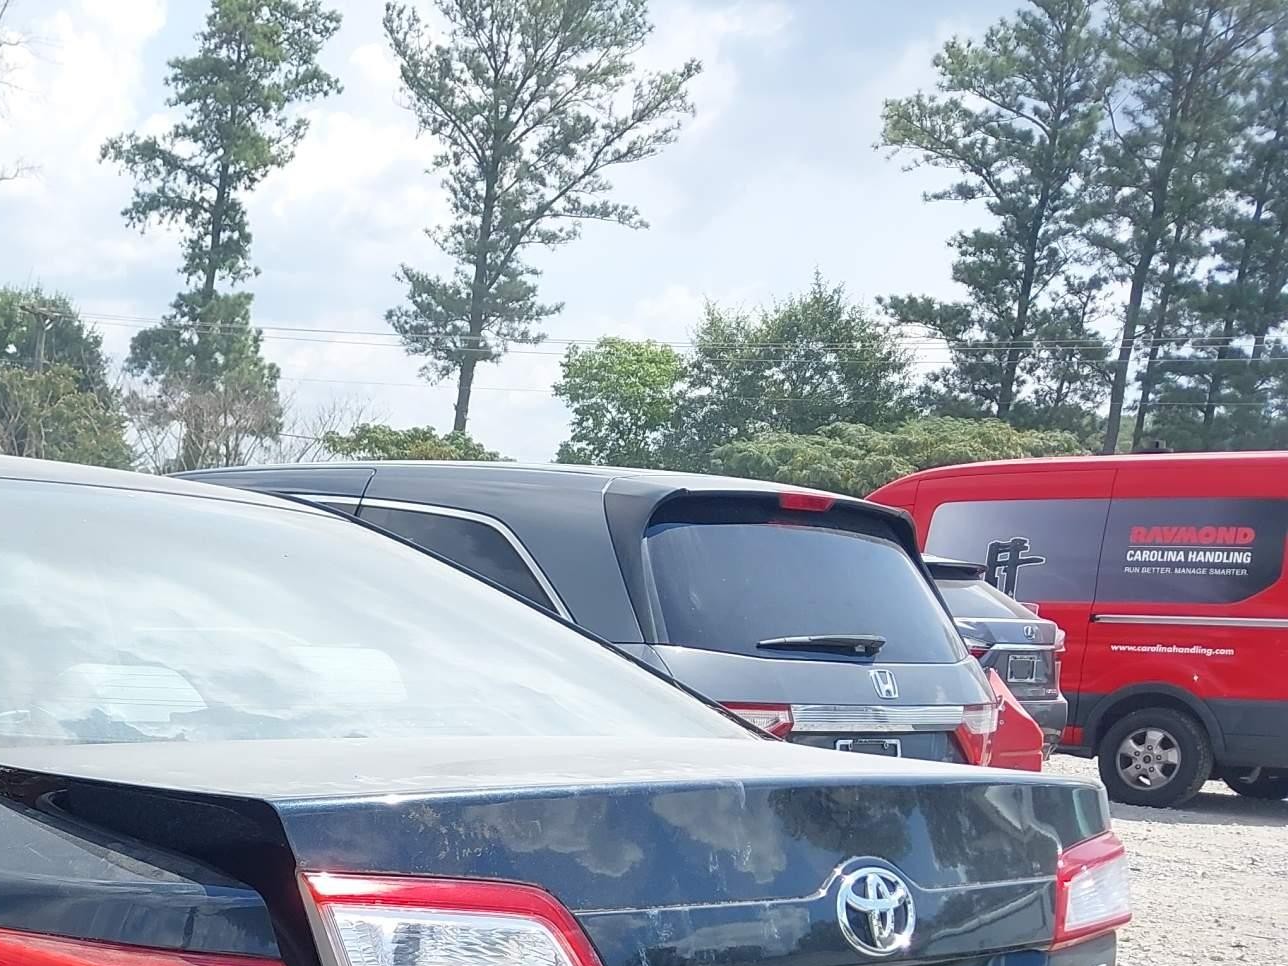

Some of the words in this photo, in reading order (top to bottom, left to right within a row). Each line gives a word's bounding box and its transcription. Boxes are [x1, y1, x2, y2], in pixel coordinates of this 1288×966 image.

[1129, 526, 1256, 545] RAYMOND
[1126, 550, 1185, 563] CAROLINA
[1188, 551, 1252, 564] HANDLING
[1174, 567, 1207, 575] MANAGE
[1208, 568, 1249, 576] SMARTER.
[1110, 644, 1234, 656] www.carolinahandling.com
